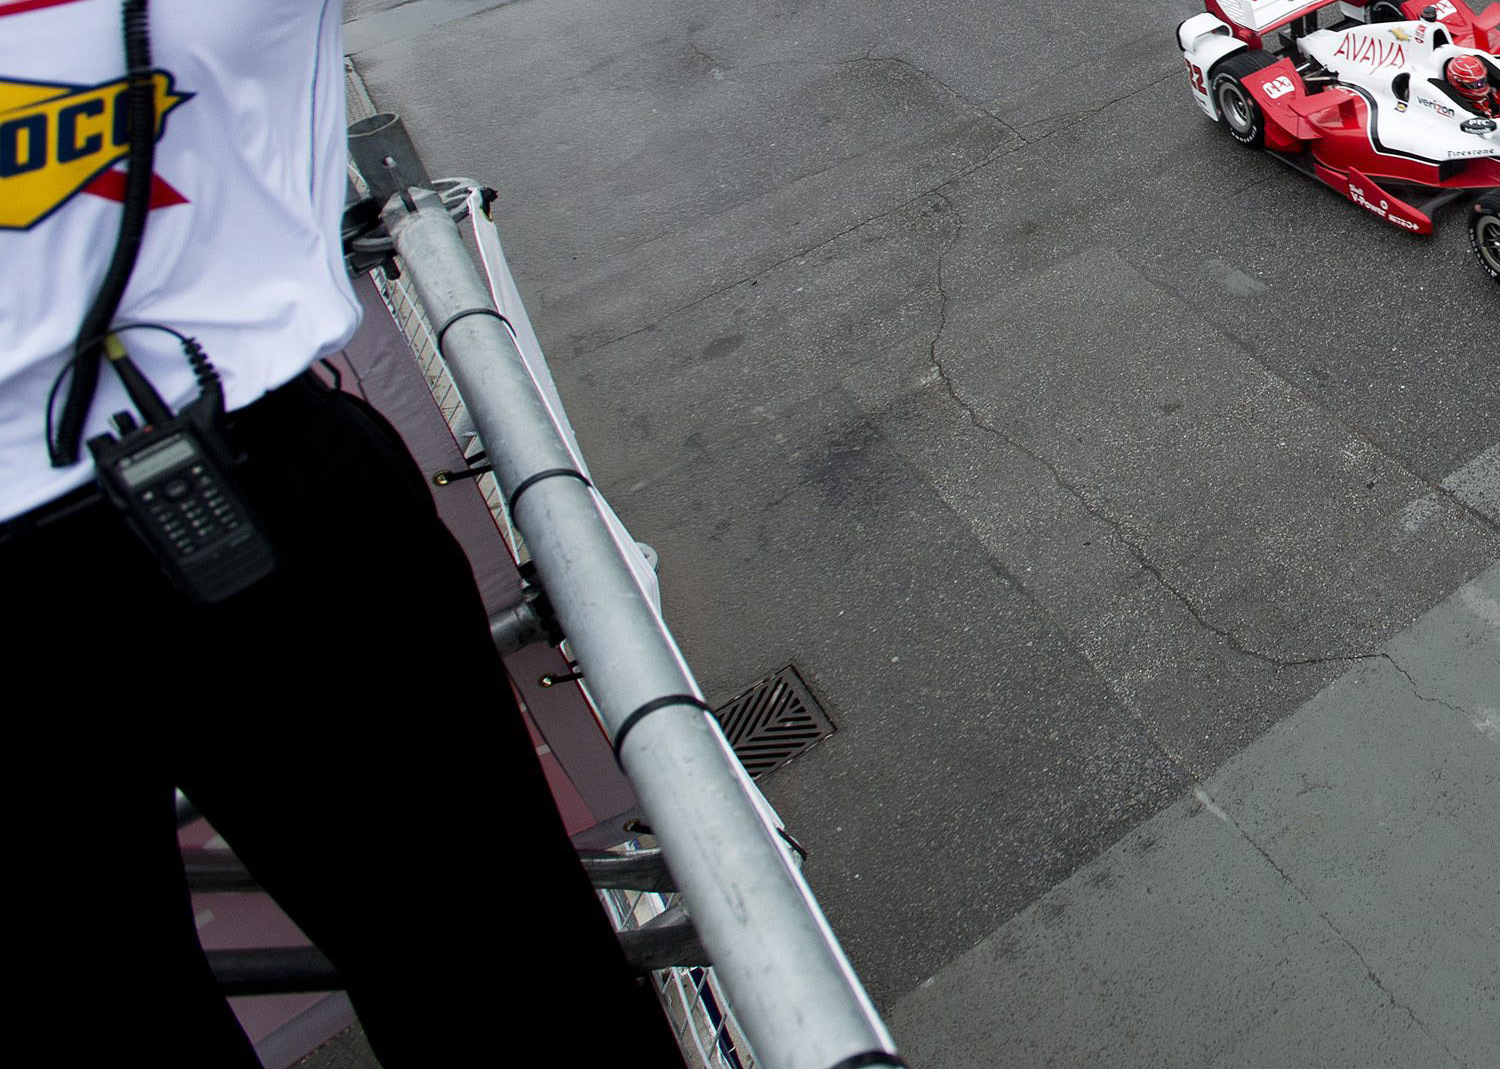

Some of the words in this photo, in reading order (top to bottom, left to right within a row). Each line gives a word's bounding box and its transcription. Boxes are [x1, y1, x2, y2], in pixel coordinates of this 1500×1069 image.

[1334, 32, 1405, 74] AVAYA
[1416, 95, 1455, 117] verizon
[1447, 148, 1495, 158] Firestone
